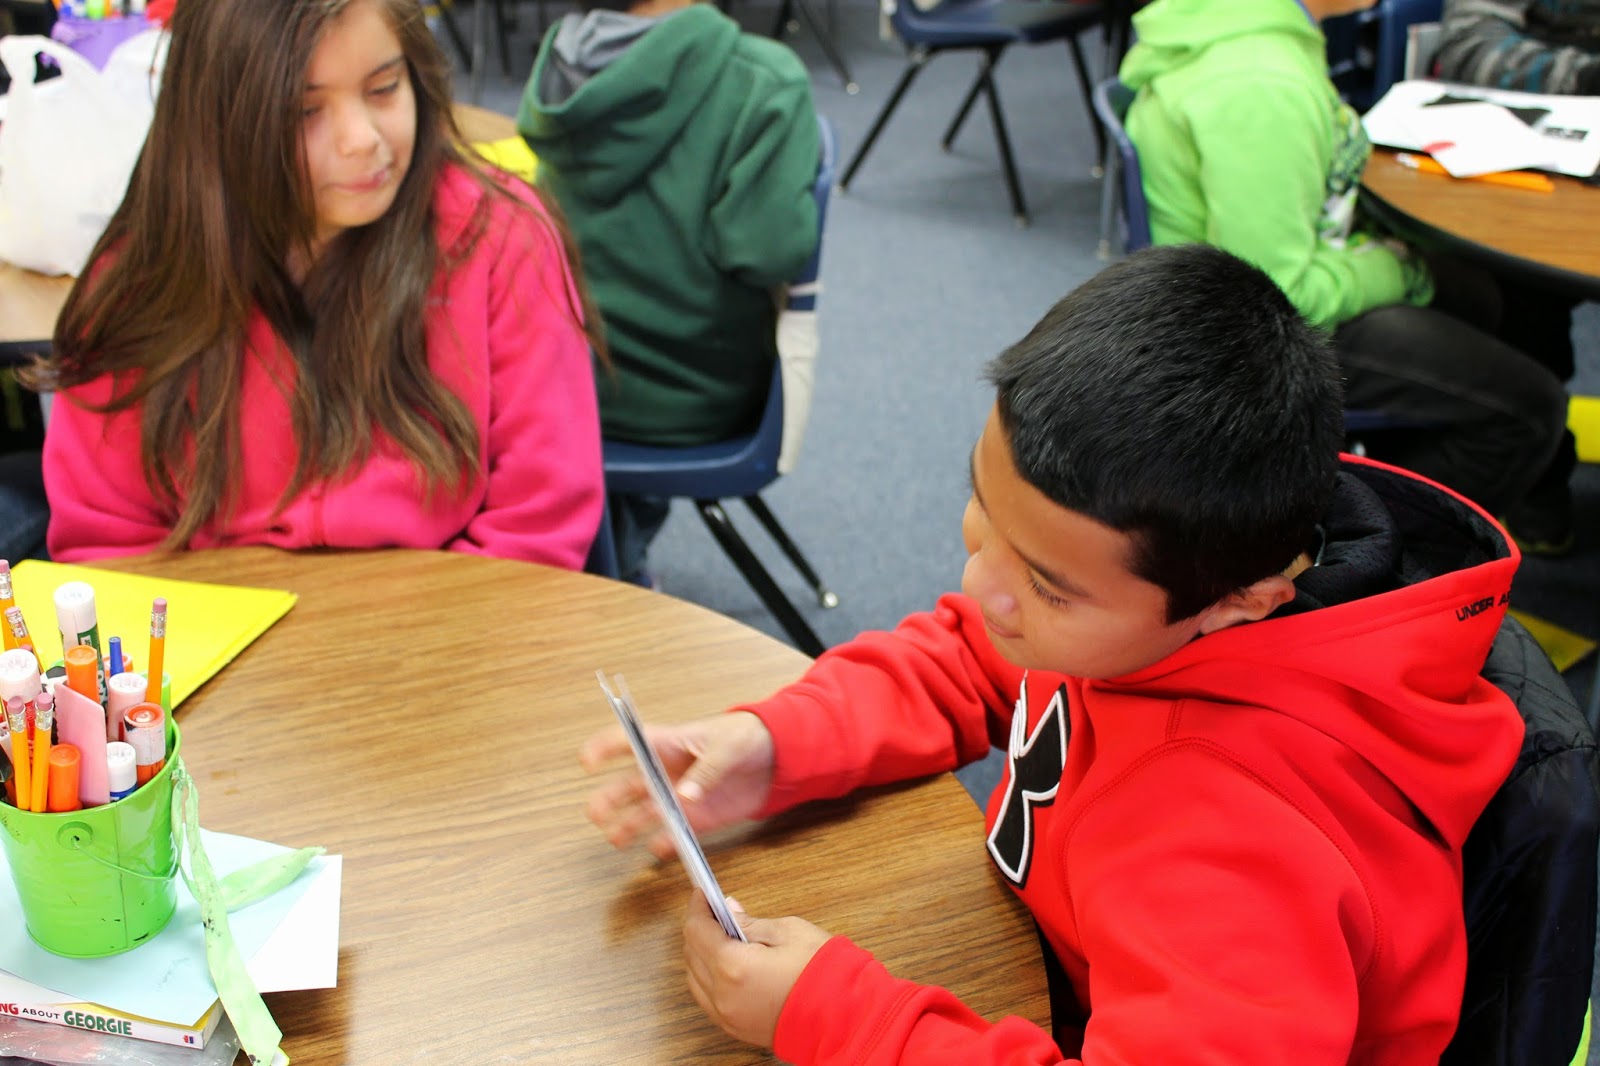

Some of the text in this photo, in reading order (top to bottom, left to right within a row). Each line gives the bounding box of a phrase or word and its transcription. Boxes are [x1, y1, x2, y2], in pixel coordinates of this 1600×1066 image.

[1456, 596, 1494, 622] UNDER
[22, 1007, 60, 1020] ABOUT
[64, 1010, 133, 1036] GEORGIE
